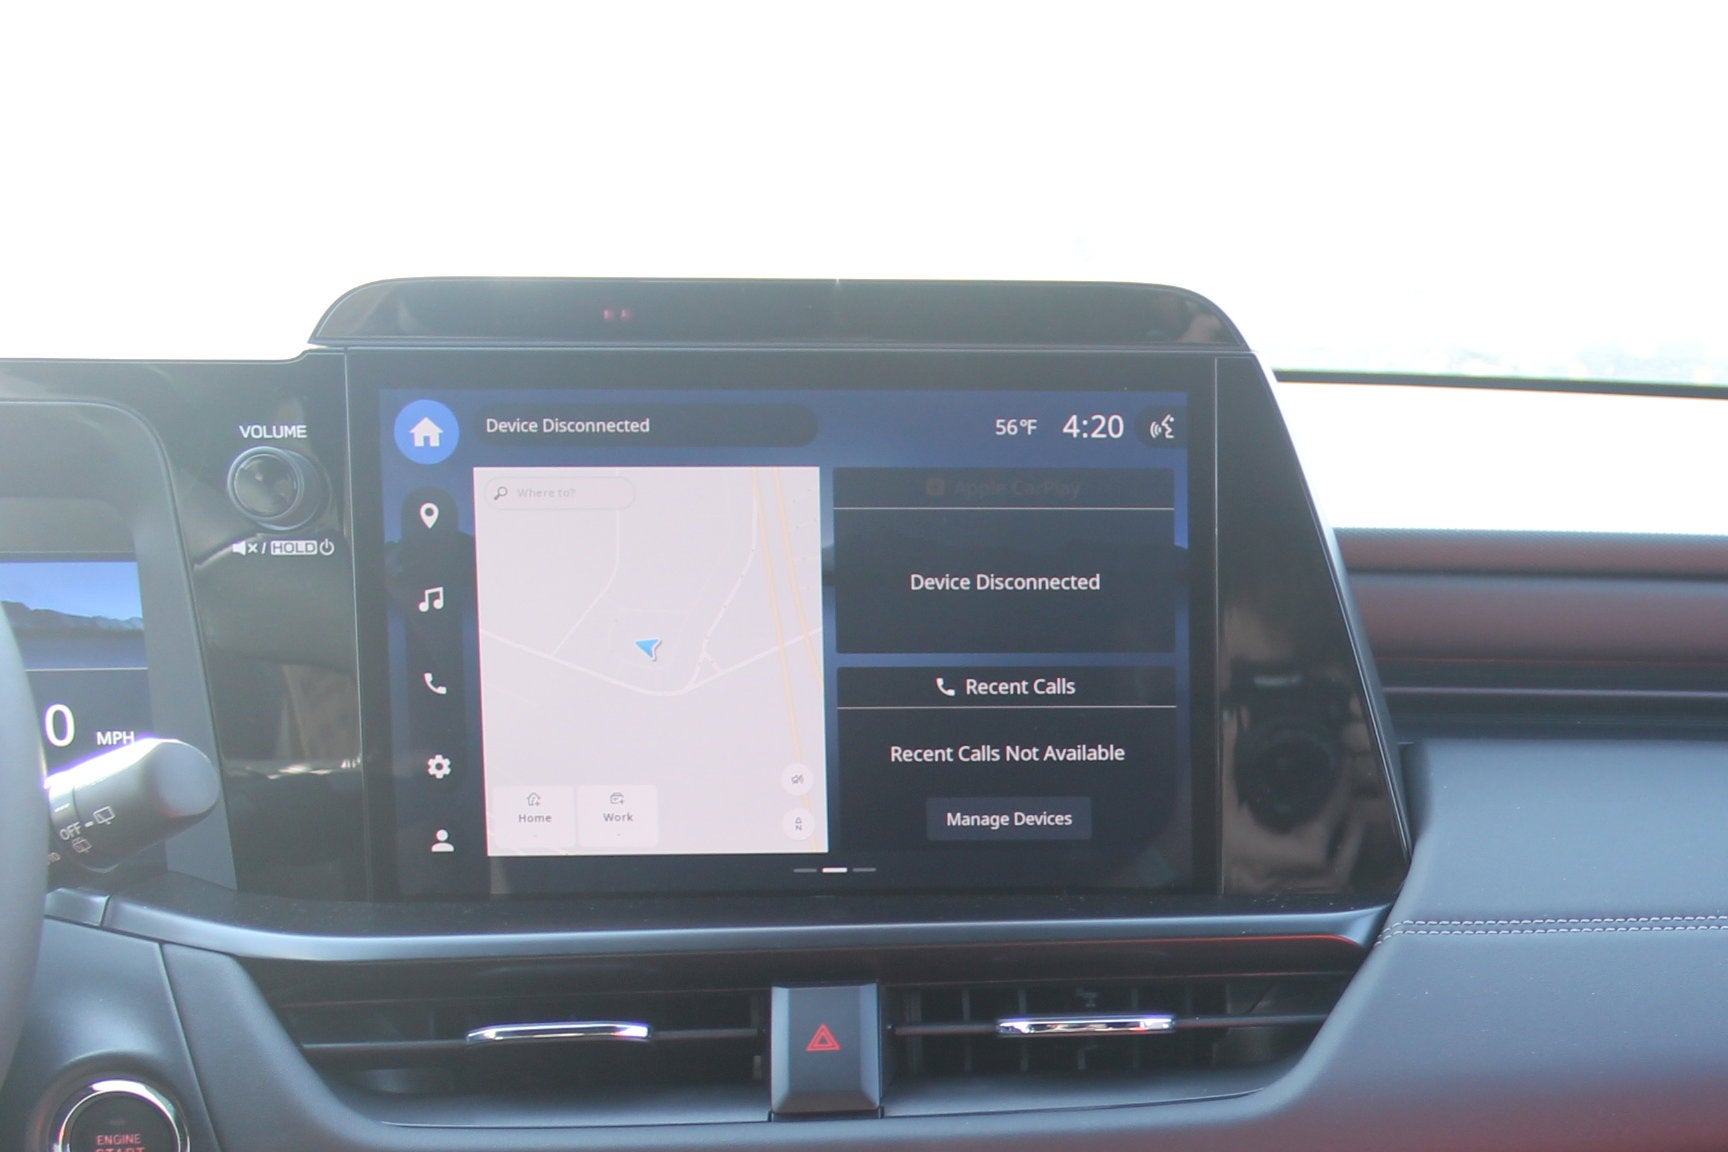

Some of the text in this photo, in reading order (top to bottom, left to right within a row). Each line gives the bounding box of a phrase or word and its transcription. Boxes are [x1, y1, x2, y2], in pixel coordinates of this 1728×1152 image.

[239, 425, 308, 439] VOLUME
[486, 418, 650, 433] Device Disconnected
[1062, 414, 1124, 439] 4:20
[517, 488, 576, 498] Where to?
[272, 541, 317, 555] HOLD
[910, 573, 1100, 591] Device Disconnected
[966, 678, 1076, 695] Recent Calls
[45, 704, 75, 747] 0
[96, 731, 135, 746] MPH
[890, 744, 1126, 762] Recent Calls Not Available
[518, 814, 552, 823] Home
[603, 812, 633, 822] Work
[946, 811, 1072, 830] Manage Devices
[59, 821, 81, 841] OFF
[96, 1133, 142, 1146] ENGINE
